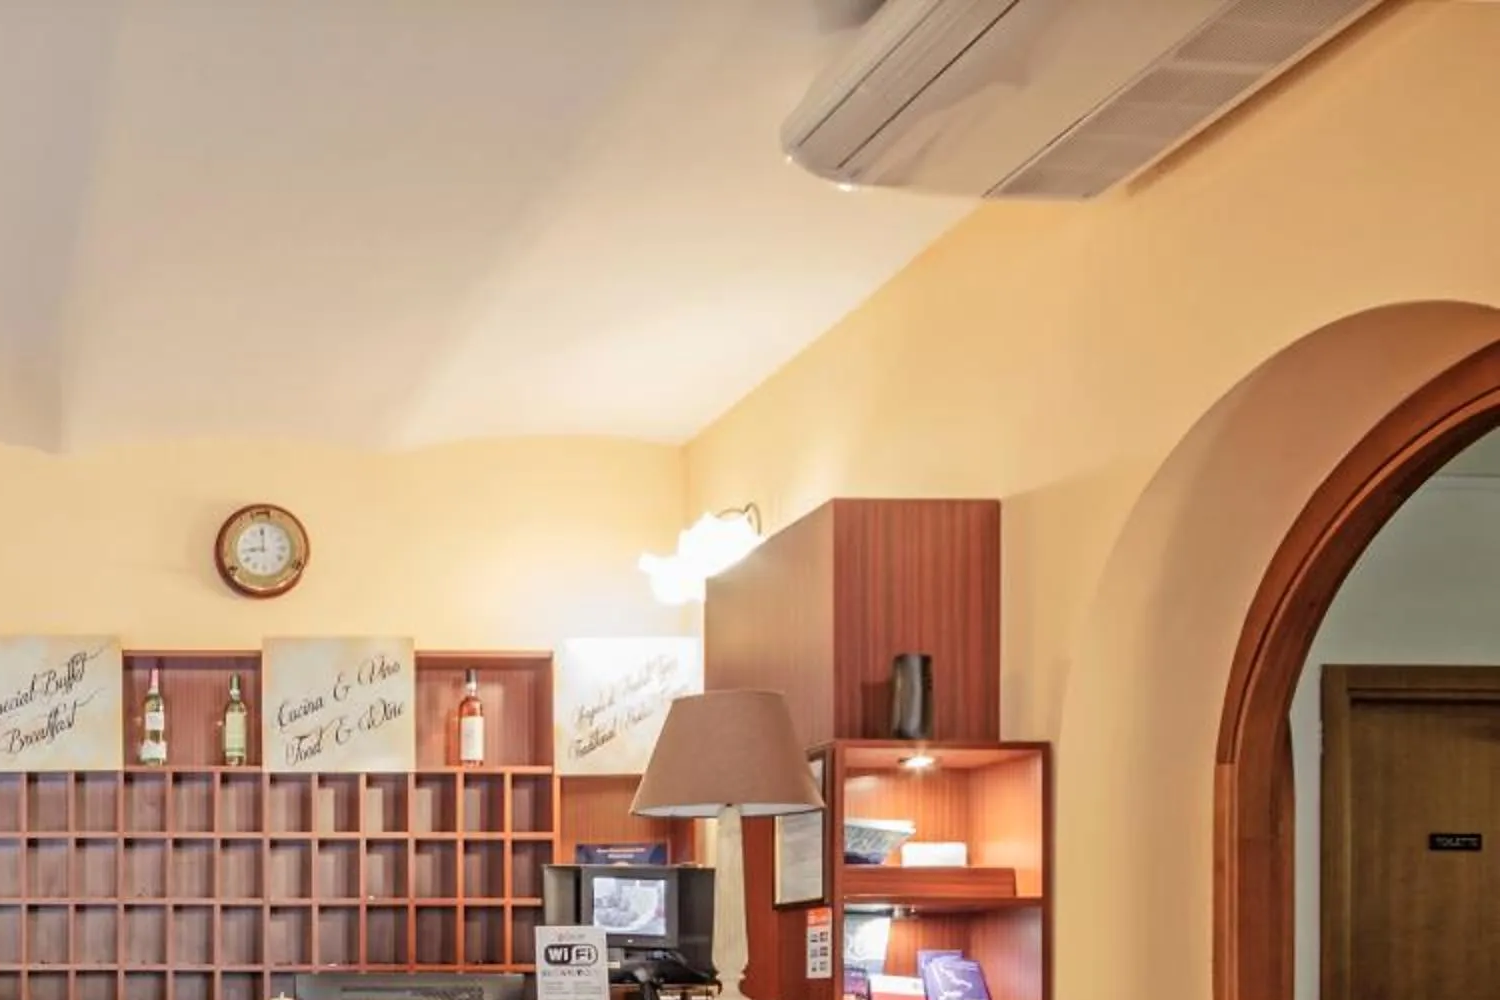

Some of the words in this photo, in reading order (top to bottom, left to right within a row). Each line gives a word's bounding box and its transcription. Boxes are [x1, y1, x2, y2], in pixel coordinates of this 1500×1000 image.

[274, 695, 325, 732] Cucina
[285, 727, 324, 766] Food
[358, 697, 404, 732] Wine
